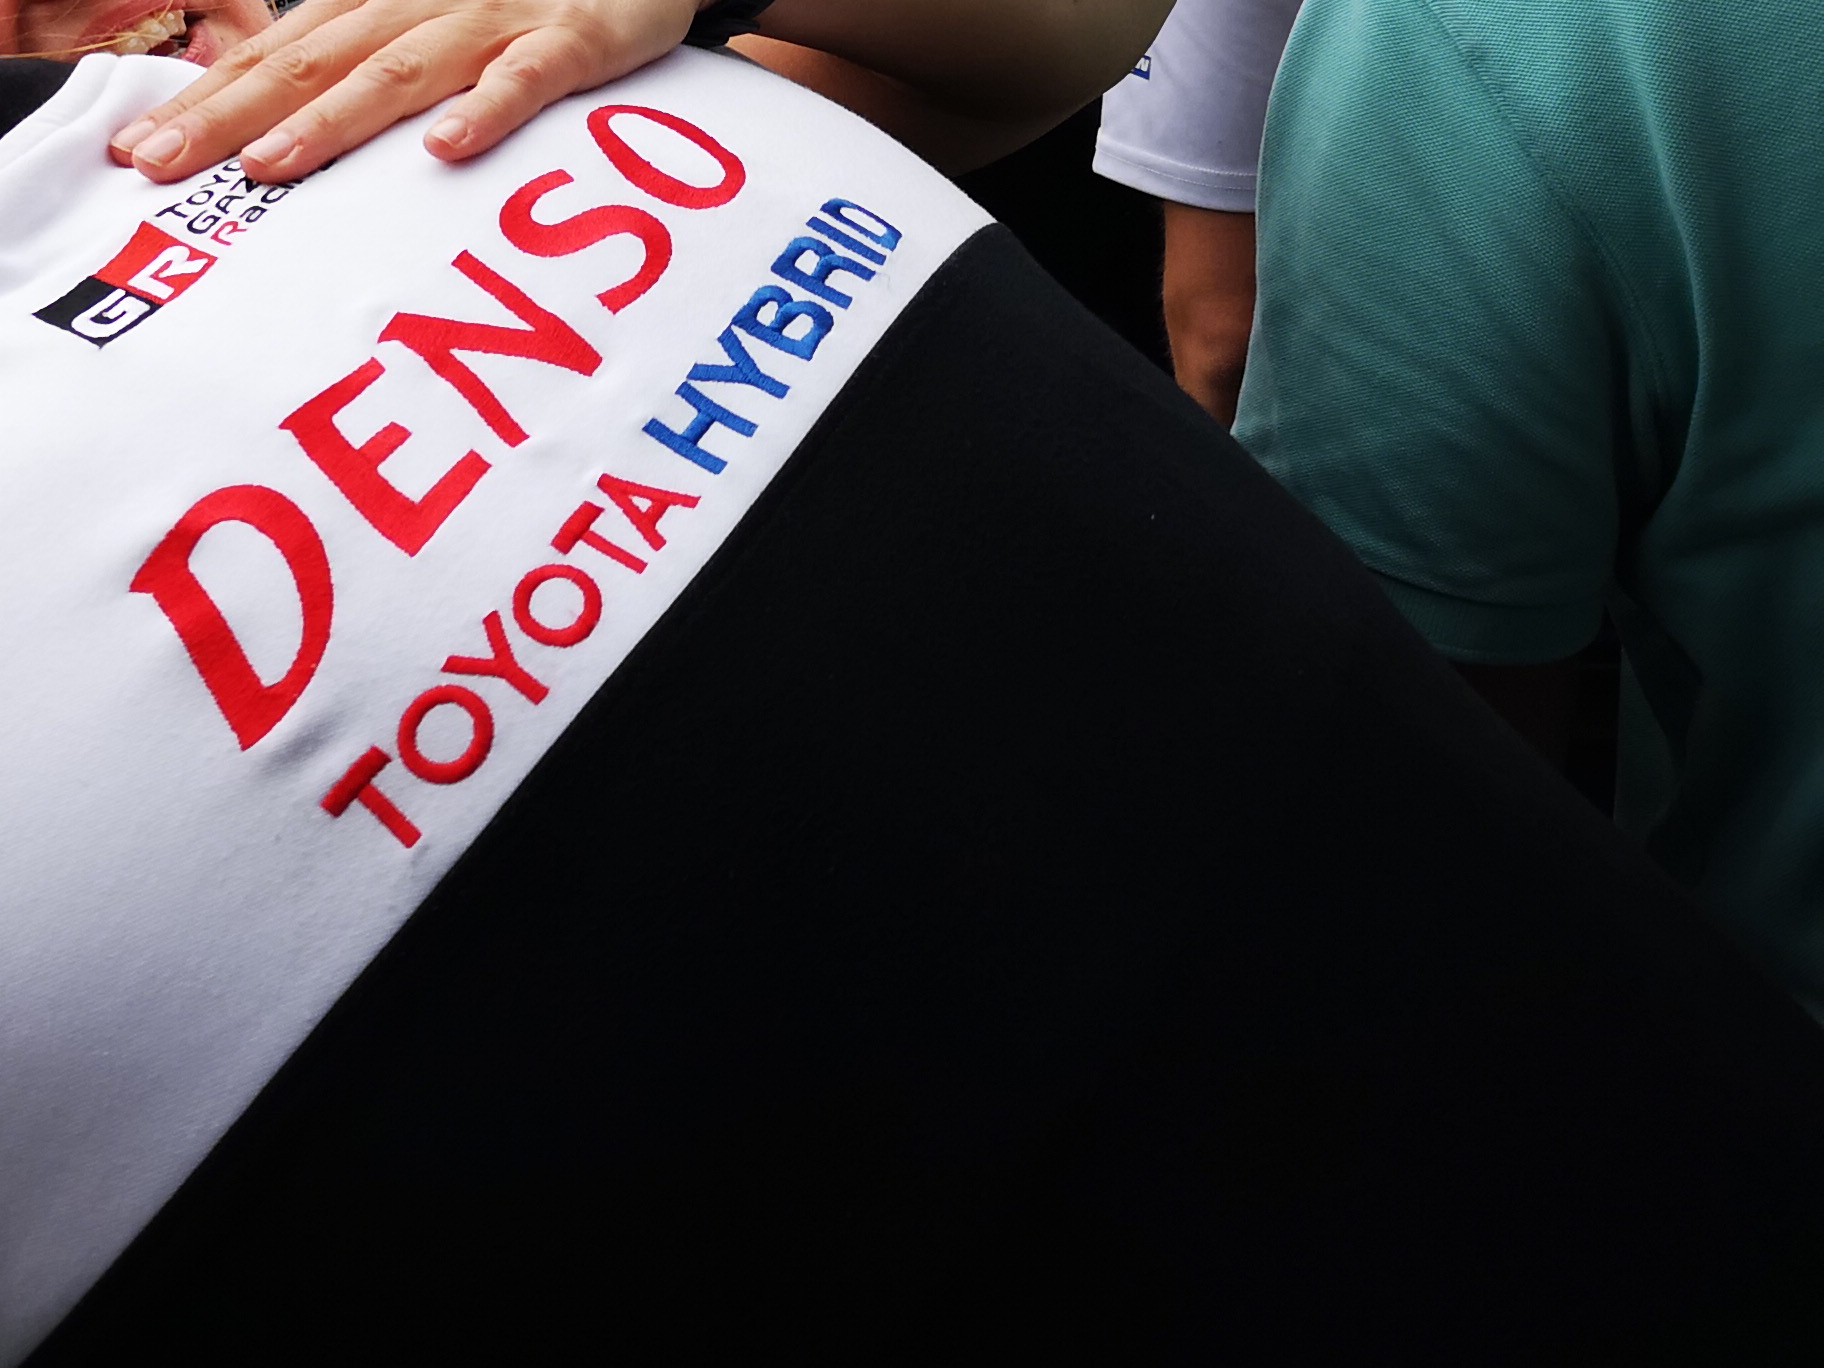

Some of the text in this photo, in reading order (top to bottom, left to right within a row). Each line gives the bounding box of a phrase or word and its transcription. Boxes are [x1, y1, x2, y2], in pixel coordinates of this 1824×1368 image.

[153, 158, 244, 219] TOYO
[186, 175, 259, 235] GAZ
[70, 244, 209, 339] GR
[128, 104, 747, 751] DENSO
[320, 195, 904, 851] TOYOTA HYBRID
